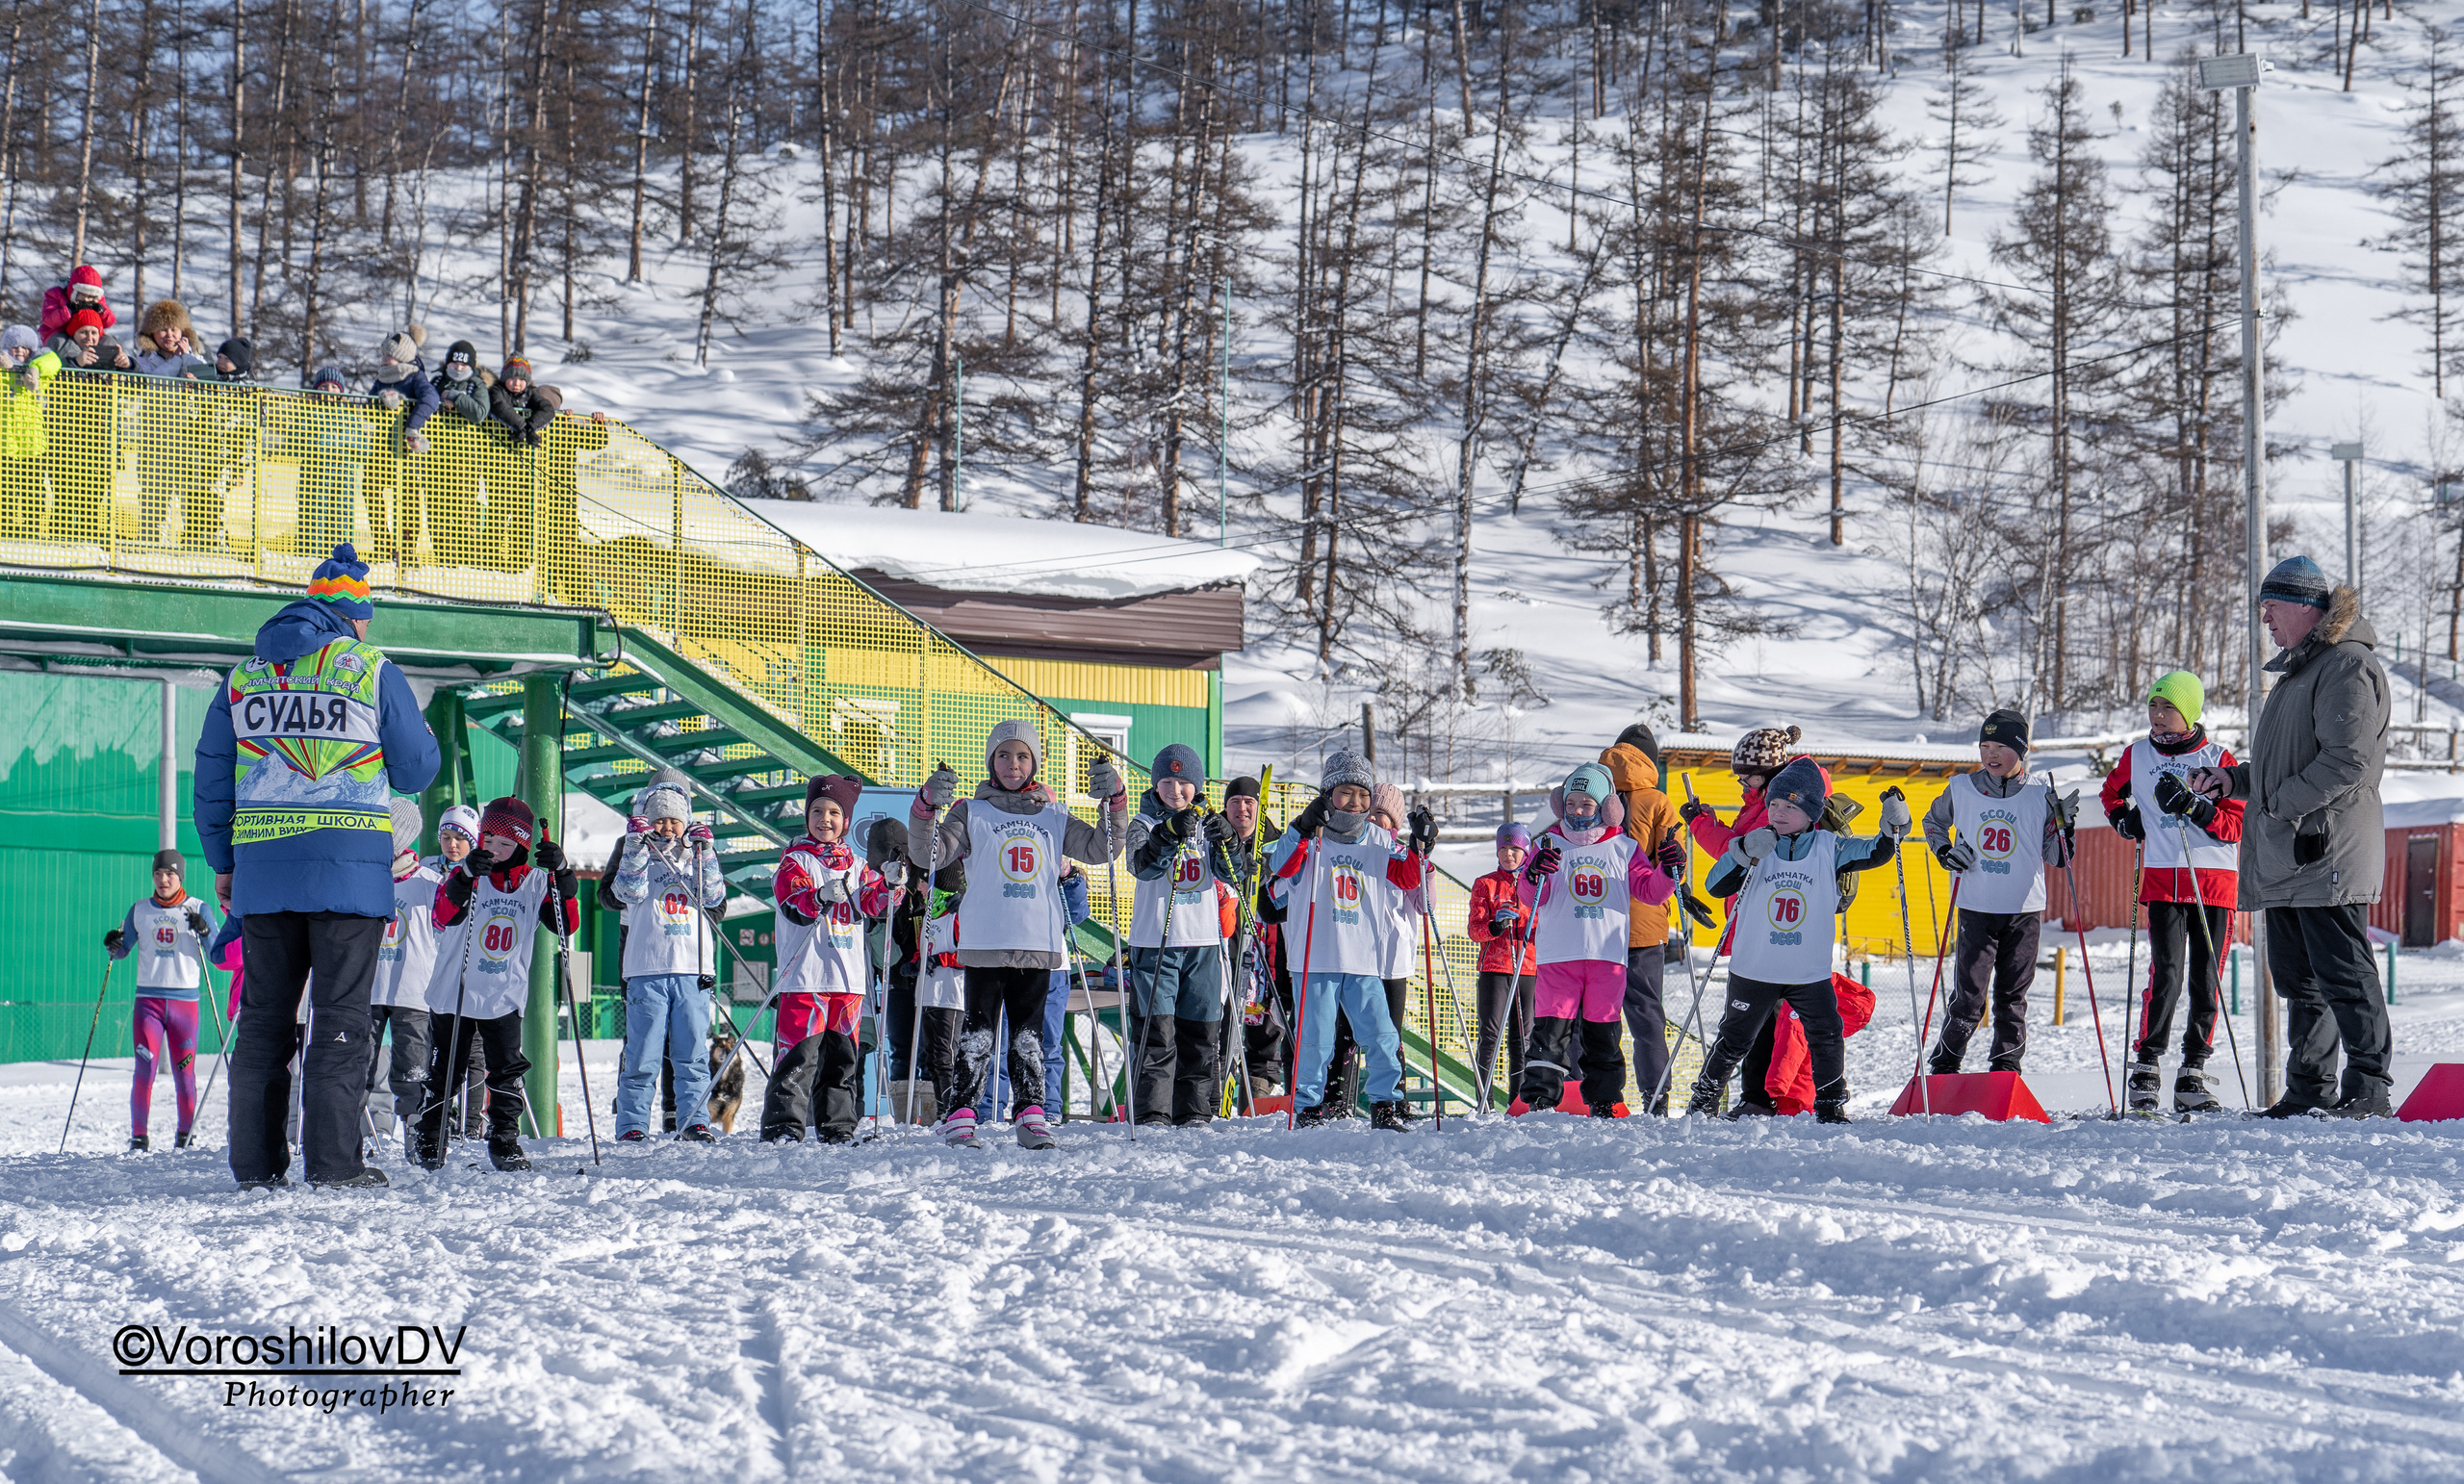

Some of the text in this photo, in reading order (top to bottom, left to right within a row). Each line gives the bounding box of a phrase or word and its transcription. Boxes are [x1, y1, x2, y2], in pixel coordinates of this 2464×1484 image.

[325, 678, 361, 694] КРАЙ
[244, 695, 346, 733] СУДЬЯ
[235, 814, 377, 830] ОРТИВНАЯ ШКОЛА
[1979, 808, 2017, 826] БСОШ
[992, 819, 1049, 838] КАМЧАТКА
[1004, 828, 1036, 839] БСОШ
[1983, 827, 2011, 853] 26
[1008, 846, 1035, 873] 15
[1329, 854, 1364, 872] БСОШ
[1569, 856, 1606, 871] БСОШ
[1980, 858, 2011, 875] ЭССО
[1173, 858, 1200, 883] 86
[1764, 871, 1814, 885] КАМЧАТКА
[1003, 883, 1037, 900] ЭССО
[1335, 875, 1358, 901] 16
[1575, 873, 1603, 898] 69
[1774, 879, 1803, 890] БСОШ
[481, 898, 526, 914] КАМЧАТКА
[665, 892, 689, 915] 82
[1574, 905, 1604, 920] ЭССО
[1775, 897, 1800, 922] 76
[490, 907, 518, 919] БСОШ
[924, 900, 934, 942] SPRINT
[1332, 908, 1359, 926] ЭССО
[156, 927, 174, 943] 45
[462, 891, 478, 975] MADSHUS
[484, 924, 513, 952] 80
[1769, 931, 1803, 946] ЭССО
[377, 947, 403, 961] ССО
